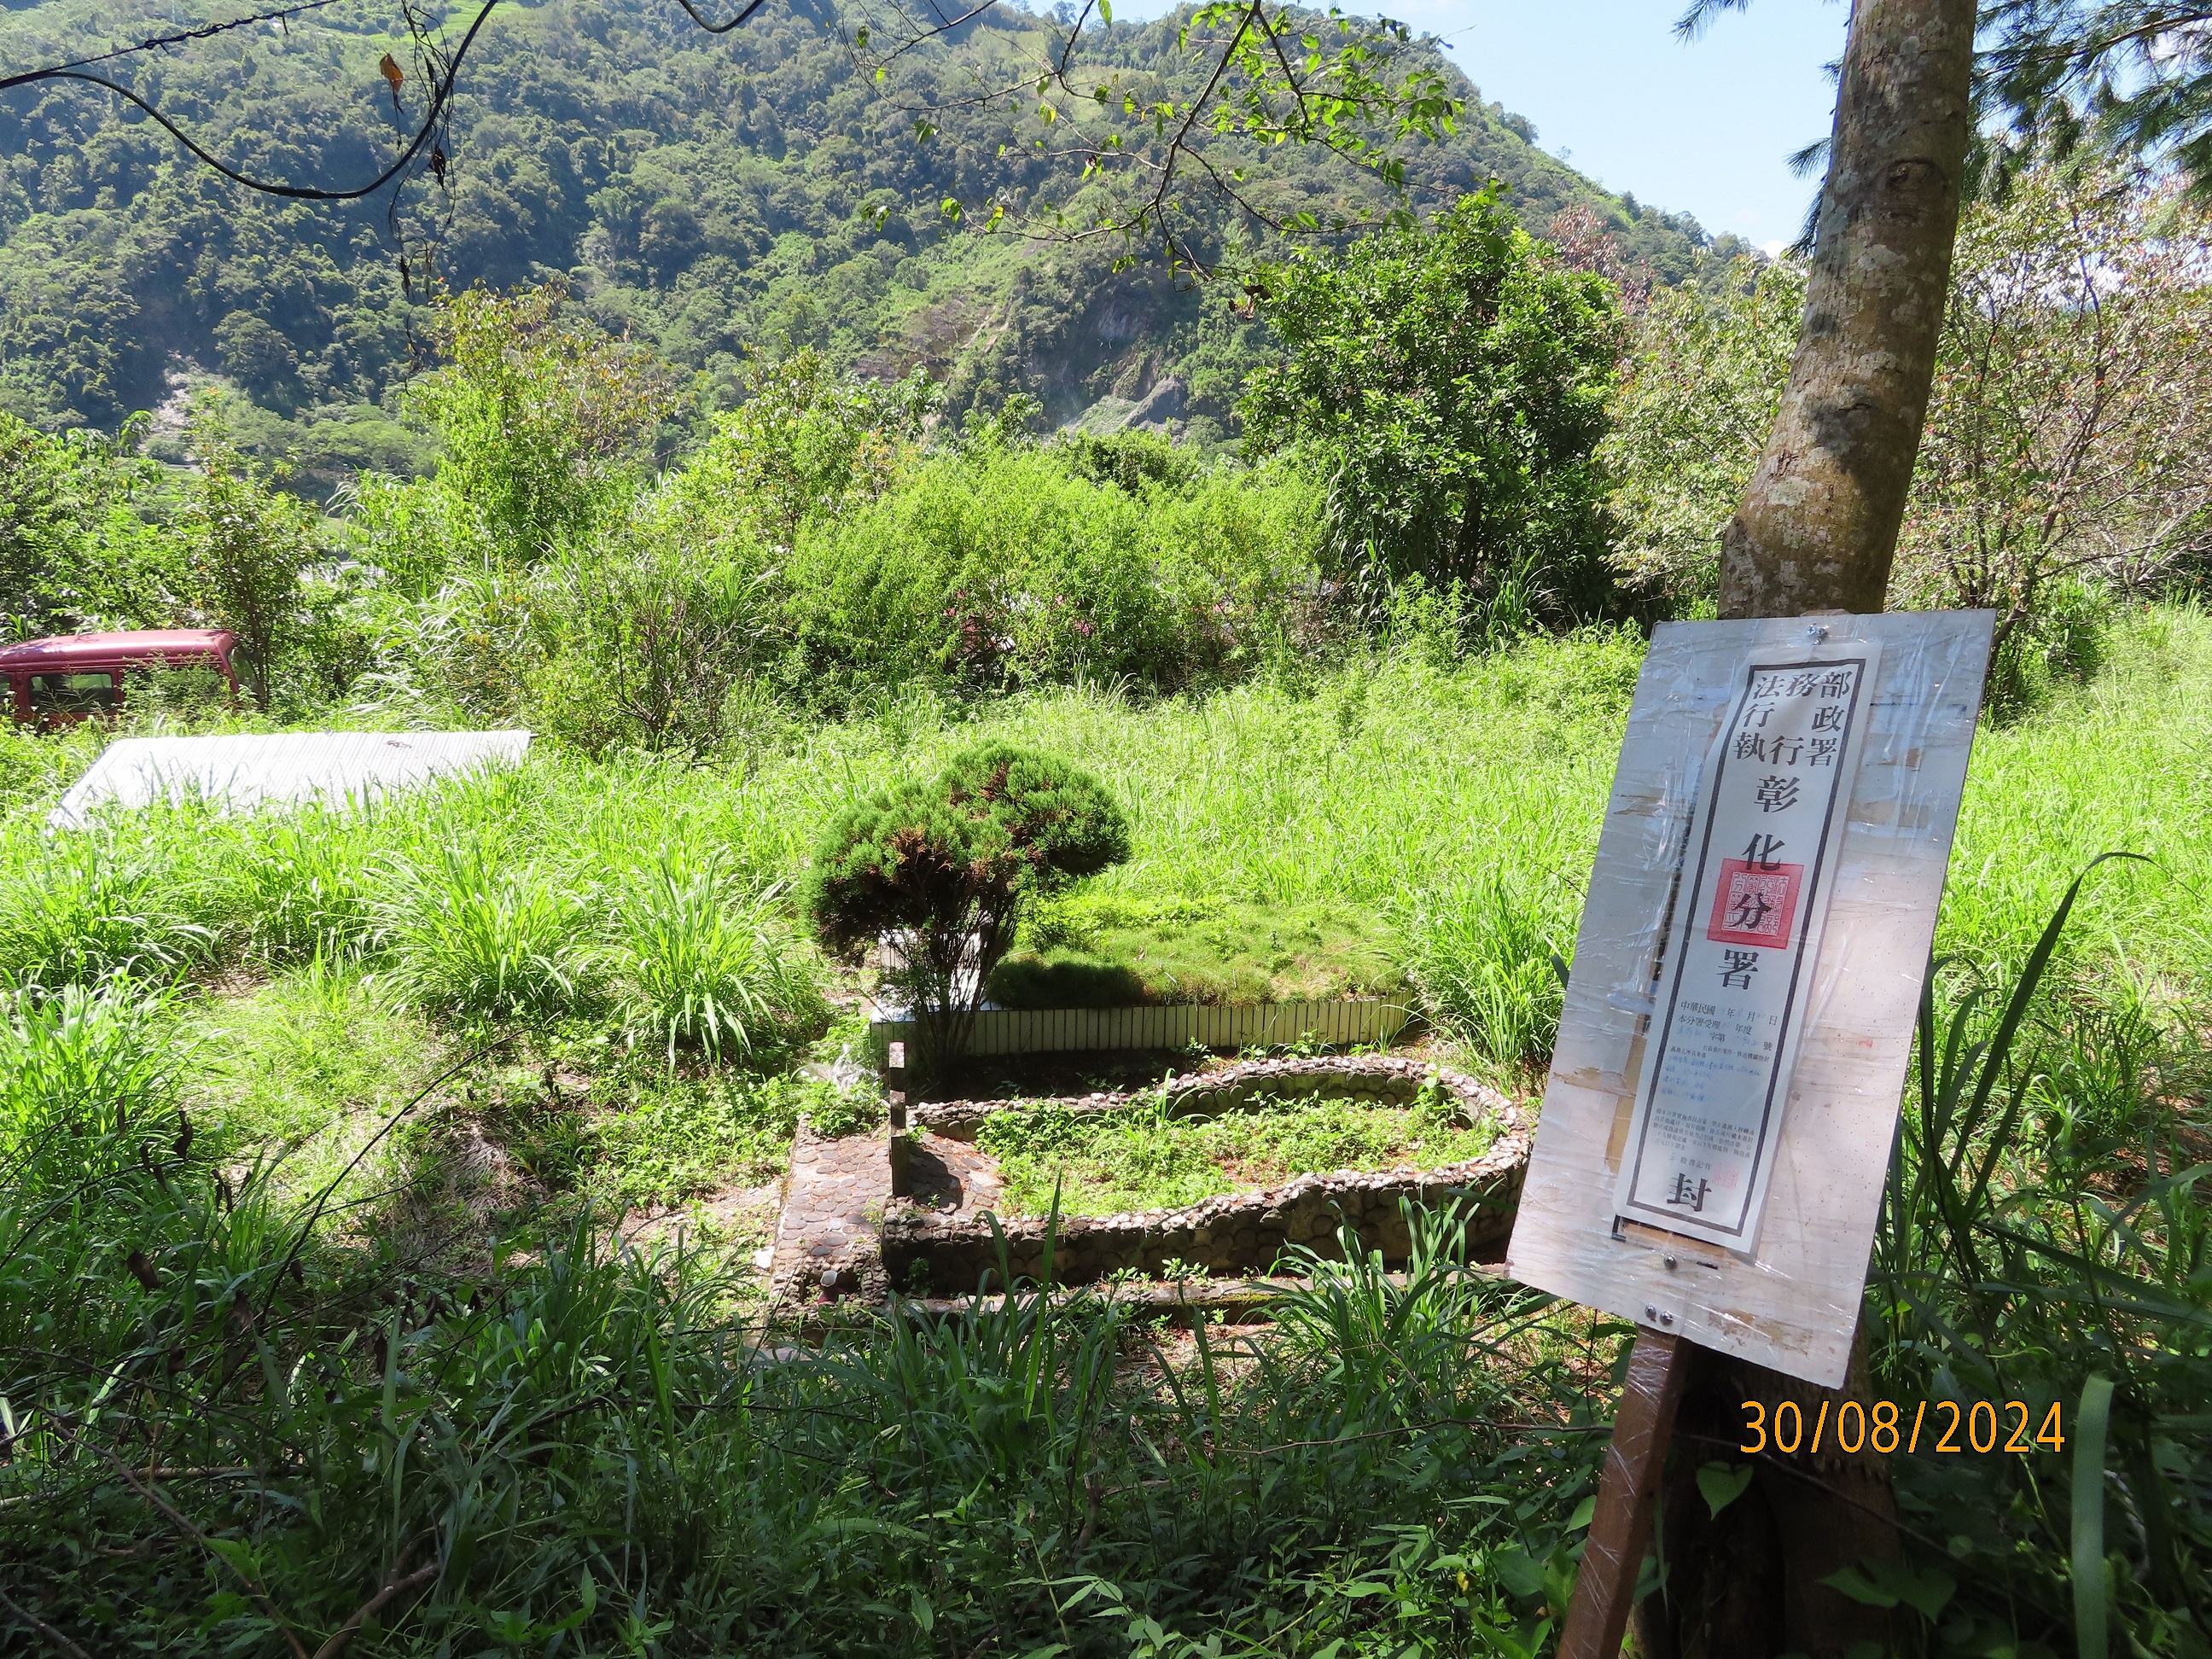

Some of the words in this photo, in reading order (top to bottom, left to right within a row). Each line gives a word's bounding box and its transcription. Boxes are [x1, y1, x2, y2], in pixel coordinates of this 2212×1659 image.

[1753, 671, 1853, 700] 法務部
[1733, 731, 1837, 767] 執行署
[1680, 1001, 1715, 1016] 中華民國
[1667, 1172, 1712, 1212] 封
